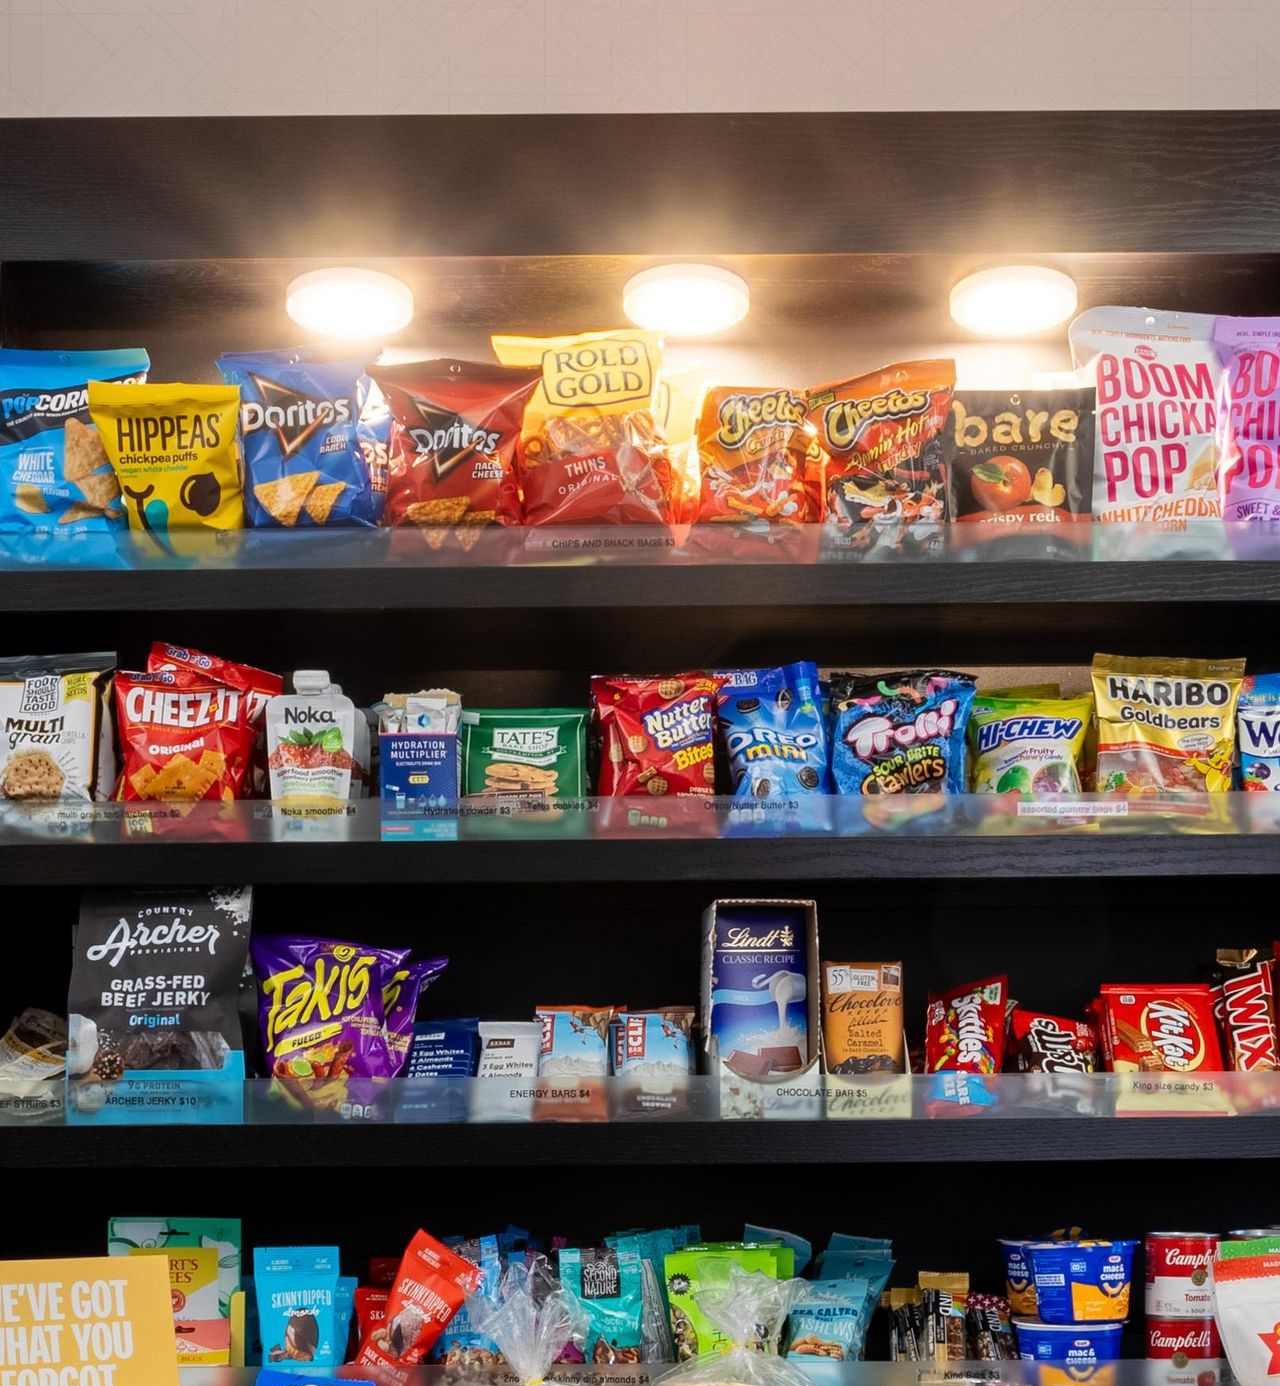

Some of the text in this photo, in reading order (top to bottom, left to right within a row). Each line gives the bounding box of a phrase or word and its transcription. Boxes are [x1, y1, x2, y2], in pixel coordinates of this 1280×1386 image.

[553, 342, 641, 376] ROLD
[553, 367, 645, 402] GOLD
[1097, 352, 1215, 406] BOOM
[240, 397, 350, 432] Doritos
[718, 390, 807, 449] Cheetos
[824, 388, 929, 449] Cheetos
[953, 400, 1080, 448] bare
[1100, 399, 1217, 448] CHICKA
[116, 413, 220, 453] HIPPEAS
[408, 422, 503, 456] Doritos
[18, 451, 55, 471] WHITE
[119, 450, 199, 468] chickpea puffs
[564, 455, 608, 477] THINS
[12, 468, 55, 485] CHEDDAR
[1103, 442, 1188, 503] POP
[551, 538, 676, 549] CHIPS AND SNACK BAGS $3
[25, 693, 57, 705] TASTE
[1109, 676, 1231, 708] HARIBO
[23, 701, 56, 713] GOOD
[125, 687, 245, 728] CHEEZ-IT
[283, 705, 336, 726] Noka
[645, 696, 708, 734] Nutter
[5, 715, 65, 735] MULTI
[1119, 705, 1221, 731] Goldbears
[496, 729, 556, 747] TATE'S
[655, 713, 710, 749] Butter
[845, 699, 960, 759] Trolli
[976, 716, 1084, 753] HI-CHEW
[8, 731, 62, 750] grain
[391, 740, 446, 750] HYDRATION
[726, 730, 817, 758] OREO
[390, 749, 446, 760] MULTIPLIER
[672, 743, 714, 770] Bites
[861, 757, 946, 796] Crawlers
[280, 806, 357, 817] Noka smoothie $4
[466, 806, 498, 816] powder
[760, 800, 800, 811] Butter $3
[137, 905, 194, 919] COUNTRY
[86, 916, 221, 968] Archer
[721, 926, 781, 949] Lindt
[129, 945, 201, 956] PROVISIONS
[721, 954, 797, 965] CLASSIC RECIPE
[110, 974, 206, 992] GRASS-FED
[100, 990, 211, 1008] BEEF JERKY
[262, 955, 379, 1053] Takis
[828, 990, 903, 1015] Chocolove
[128, 1012, 181, 1029] Original
[1224, 961, 1278, 1073] TWIX
[848, 1029, 882, 1038] Salted
[951, 993, 988, 1064] Skittles
[846, 1038, 884, 1049] Caramel
[509, 1088, 591, 1100] ENERGY BARS $4
[776, 1087, 868, 1099] CHOCOLATE BAR $5
[1132, 1081, 1215, 1092] King size candy $3
[13, 1098, 49, 1109] STRIPS
[49, 1098, 62, 1108] $3
[105, 1095, 197, 1106] ARCHER JERKY $10
[584, 1280, 618, 1297] NATURE
[1184, 1294, 1212, 1303] Tomato
[70, 1279, 129, 1321] GOT
[271, 1289, 332, 1310] SKINNYDIPPED
[70, 1321, 134, 1363] YOU
[1150, 1329, 1211, 1352] Campbell's
[943, 1369, 1001, 1380] Kind $3
